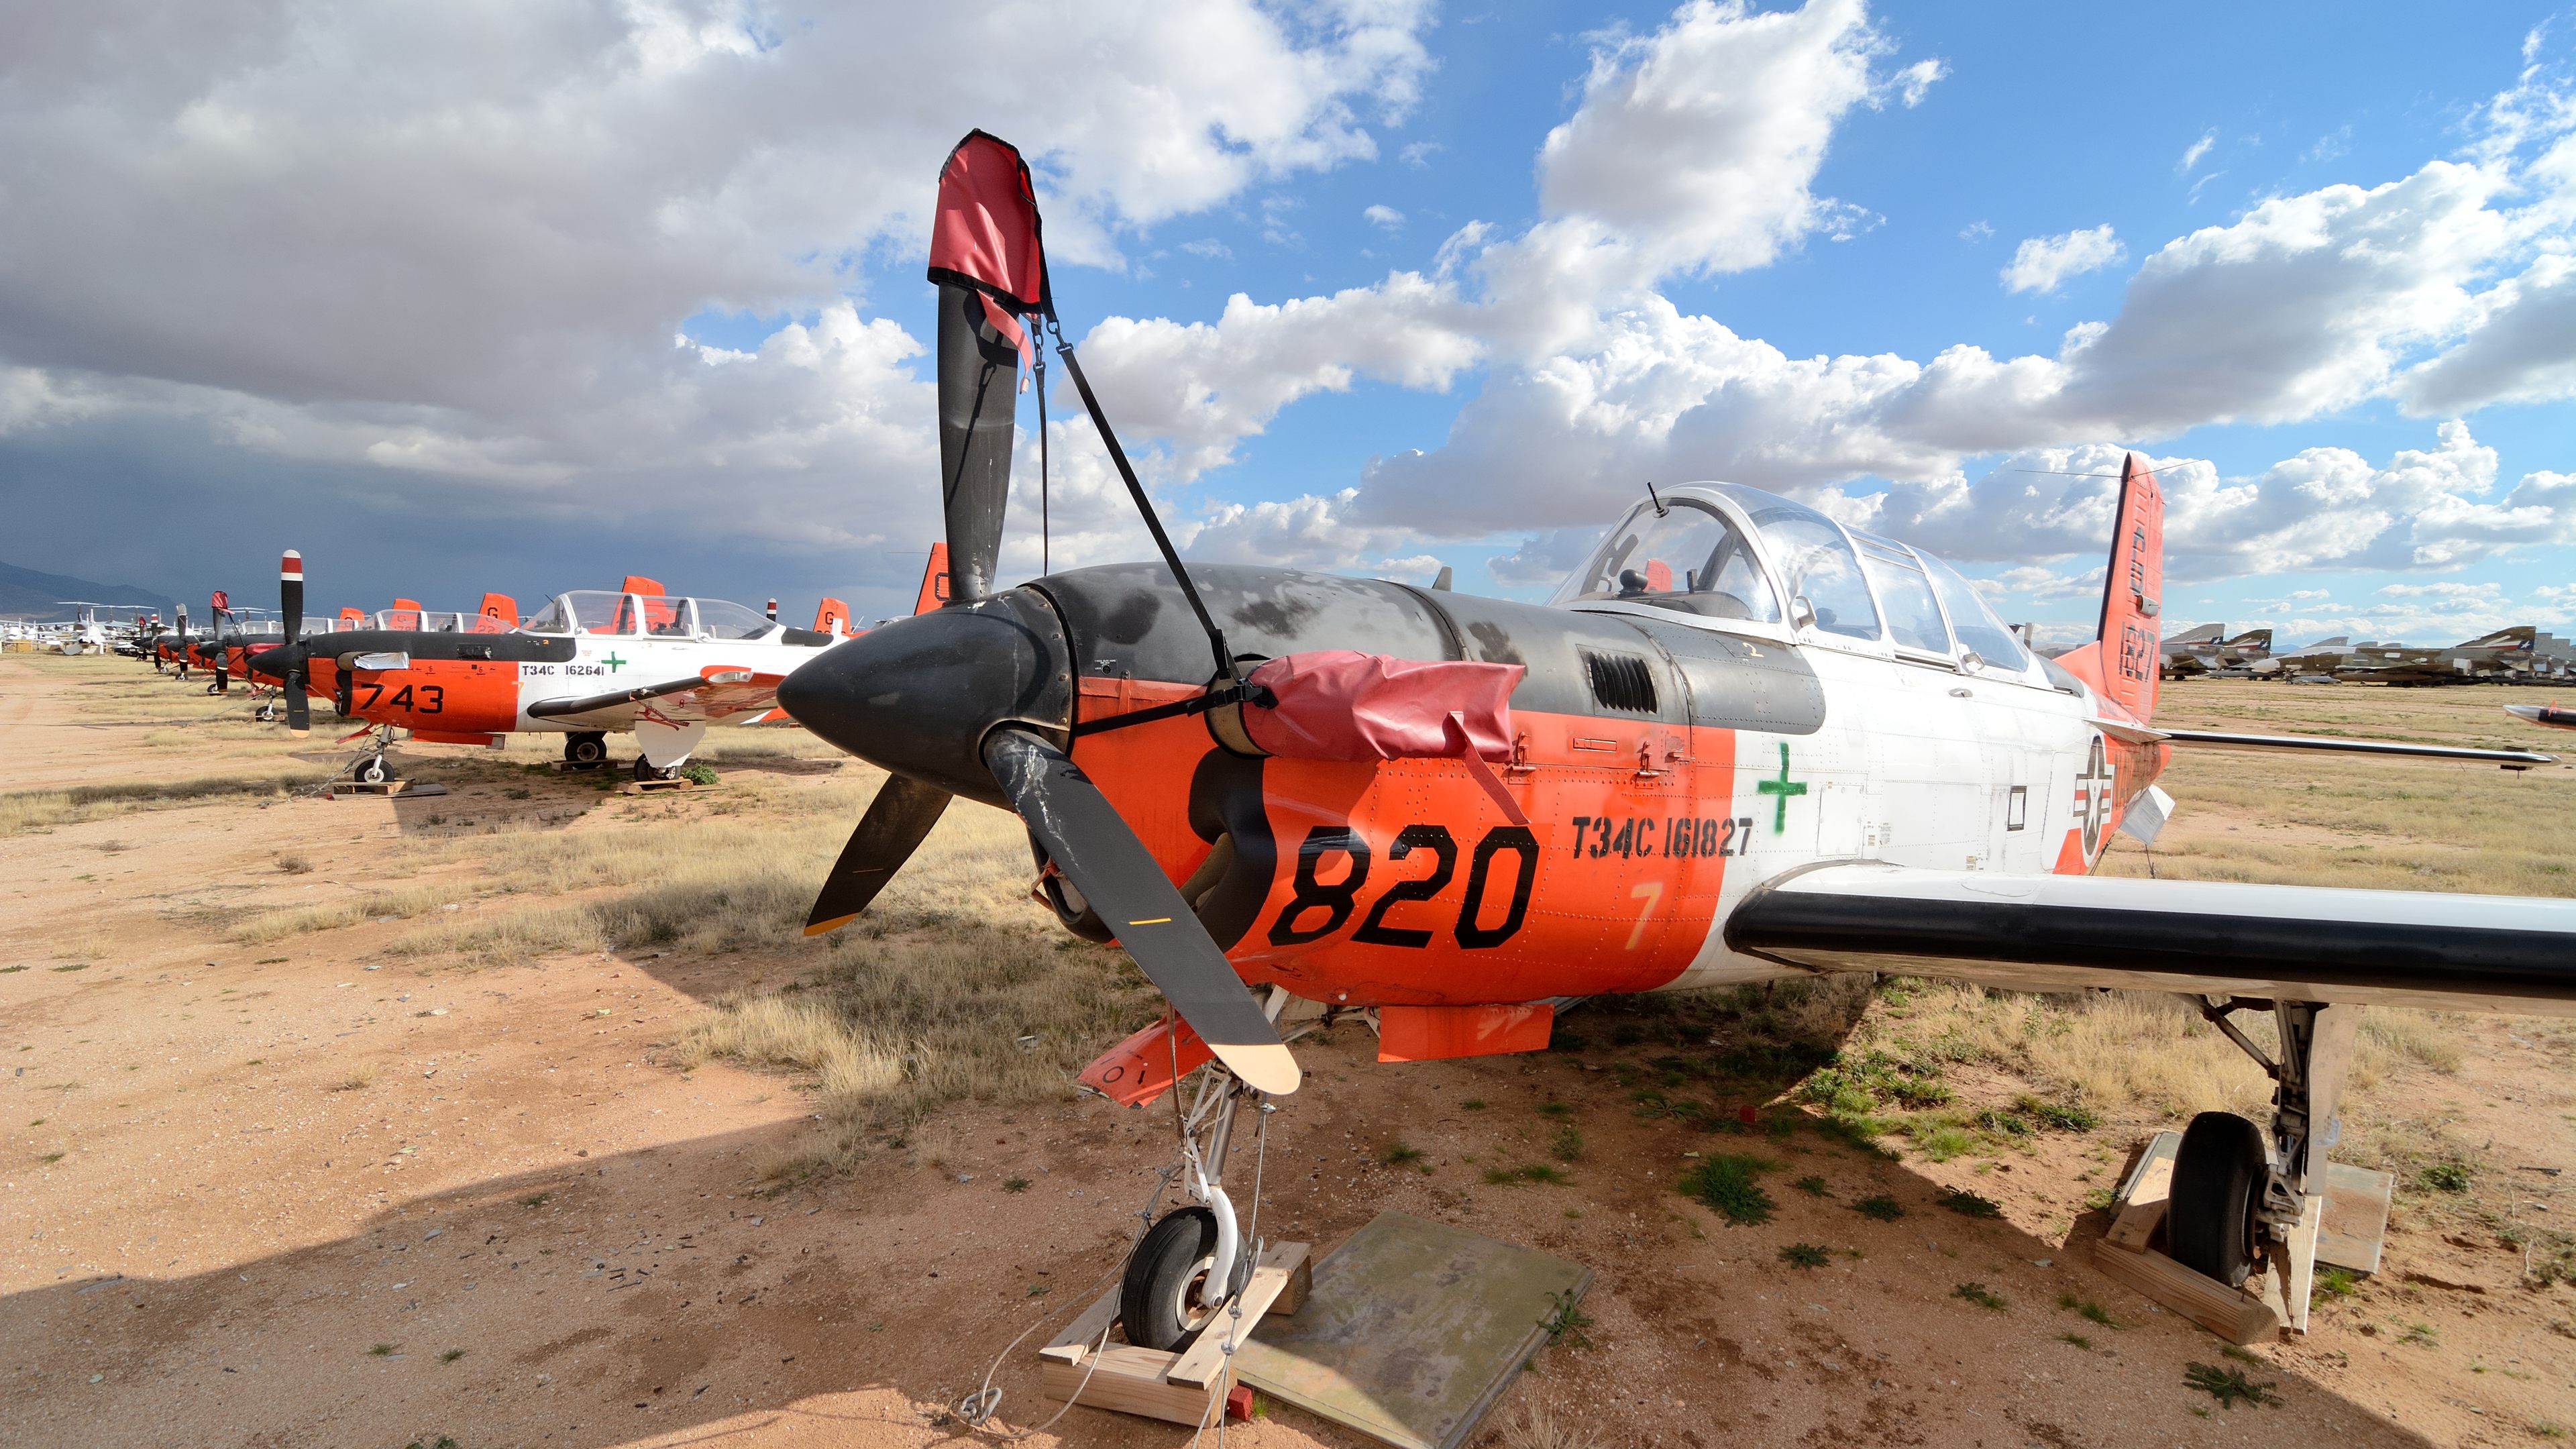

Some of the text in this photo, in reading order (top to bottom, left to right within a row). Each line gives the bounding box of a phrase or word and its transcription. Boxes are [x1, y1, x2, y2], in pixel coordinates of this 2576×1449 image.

[825, 611, 835, 625] G
[1742, 642, 1764, 658] 2
[522, 665, 604, 676] T34C 162641
[359, 683, 443, 714] 743
[512, 681, 525, 698] 7
[1572, 816, 1754, 859] T34C 161827
[1267, 825, 1540, 949] 820
[1628, 882, 1663, 951] 7
